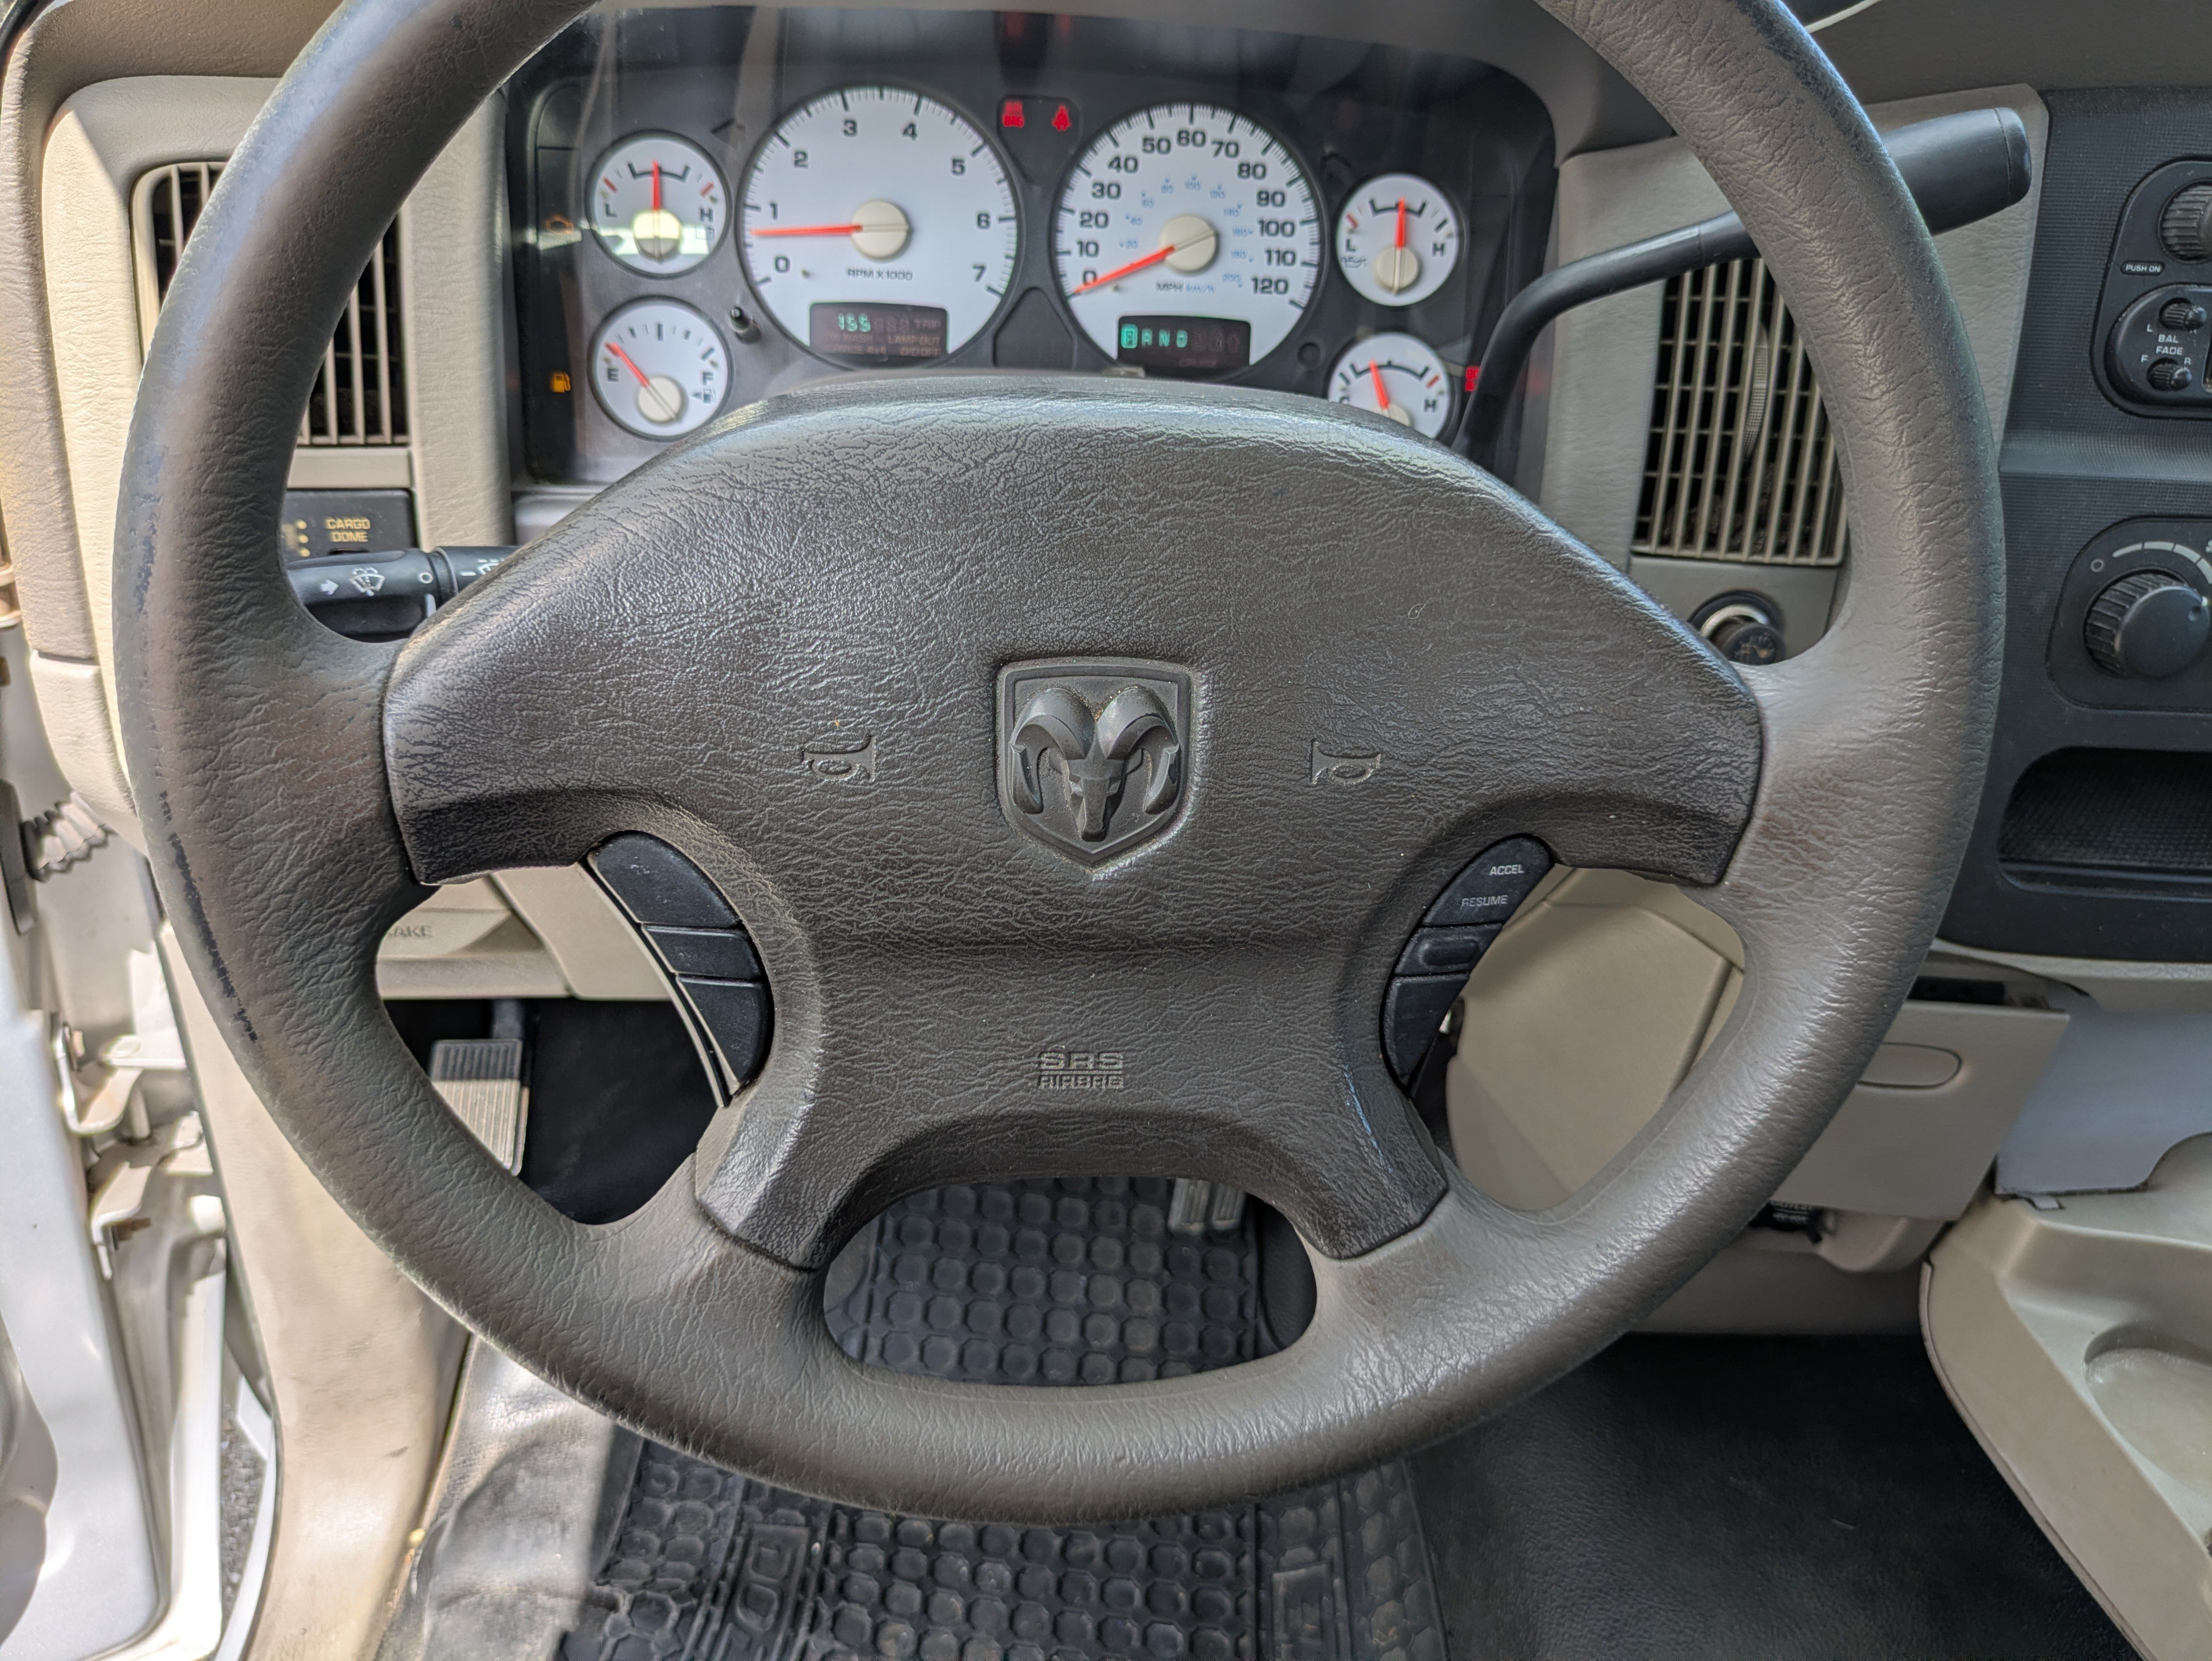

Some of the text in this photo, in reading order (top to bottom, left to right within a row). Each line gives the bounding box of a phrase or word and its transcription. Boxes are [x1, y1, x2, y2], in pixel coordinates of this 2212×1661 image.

[844, 119, 857, 135] 3
[903, 122, 917, 139] 4
[1143, 137, 1171, 154] 50
[1177, 130, 1206, 146] 60
[1212, 140, 1239, 157] 70
[794, 151, 807, 167] 2
[952, 158, 965, 174] 5
[1108, 155, 1138, 172] 40
[1238, 163, 1266, 179] 80
[1092, 182, 1121, 199] 30
[1257, 190, 1285, 207] 90
[605, 203, 616, 217] L
[700, 208, 712, 221] H
[770, 202, 777, 219] 1
[977, 213, 990, 228] 6
[1080, 211, 1108, 228] 20
[1259, 219, 1295, 237] 100
[1077, 241, 1099, 256] 10
[1346, 239, 1355, 252] L
[1433, 243, 1445, 255] H
[774, 256, 789, 272] 0
[1266, 249, 1296, 266] 110
[847, 268, 874, 278] RPM
[973, 265, 986, 281] 7
[1083, 270, 1097, 286] 0
[1252, 277, 1289, 294] 120
[2158, 334, 2178, 343] BAL
[2156, 345, 2183, 355] FADE
[607, 367, 617, 381] E
[702, 372, 712, 384] F
[1425, 399, 1437, 410] H
[327, 518, 370, 530] CARGO
[331, 531, 368, 543] DOME
[1489, 864, 1524, 875] ACCEL
[1460, 895, 1508, 908] RESUME
[388, 925, 433, 937] AKE
[1039, 1052, 1124, 1069] SRS
